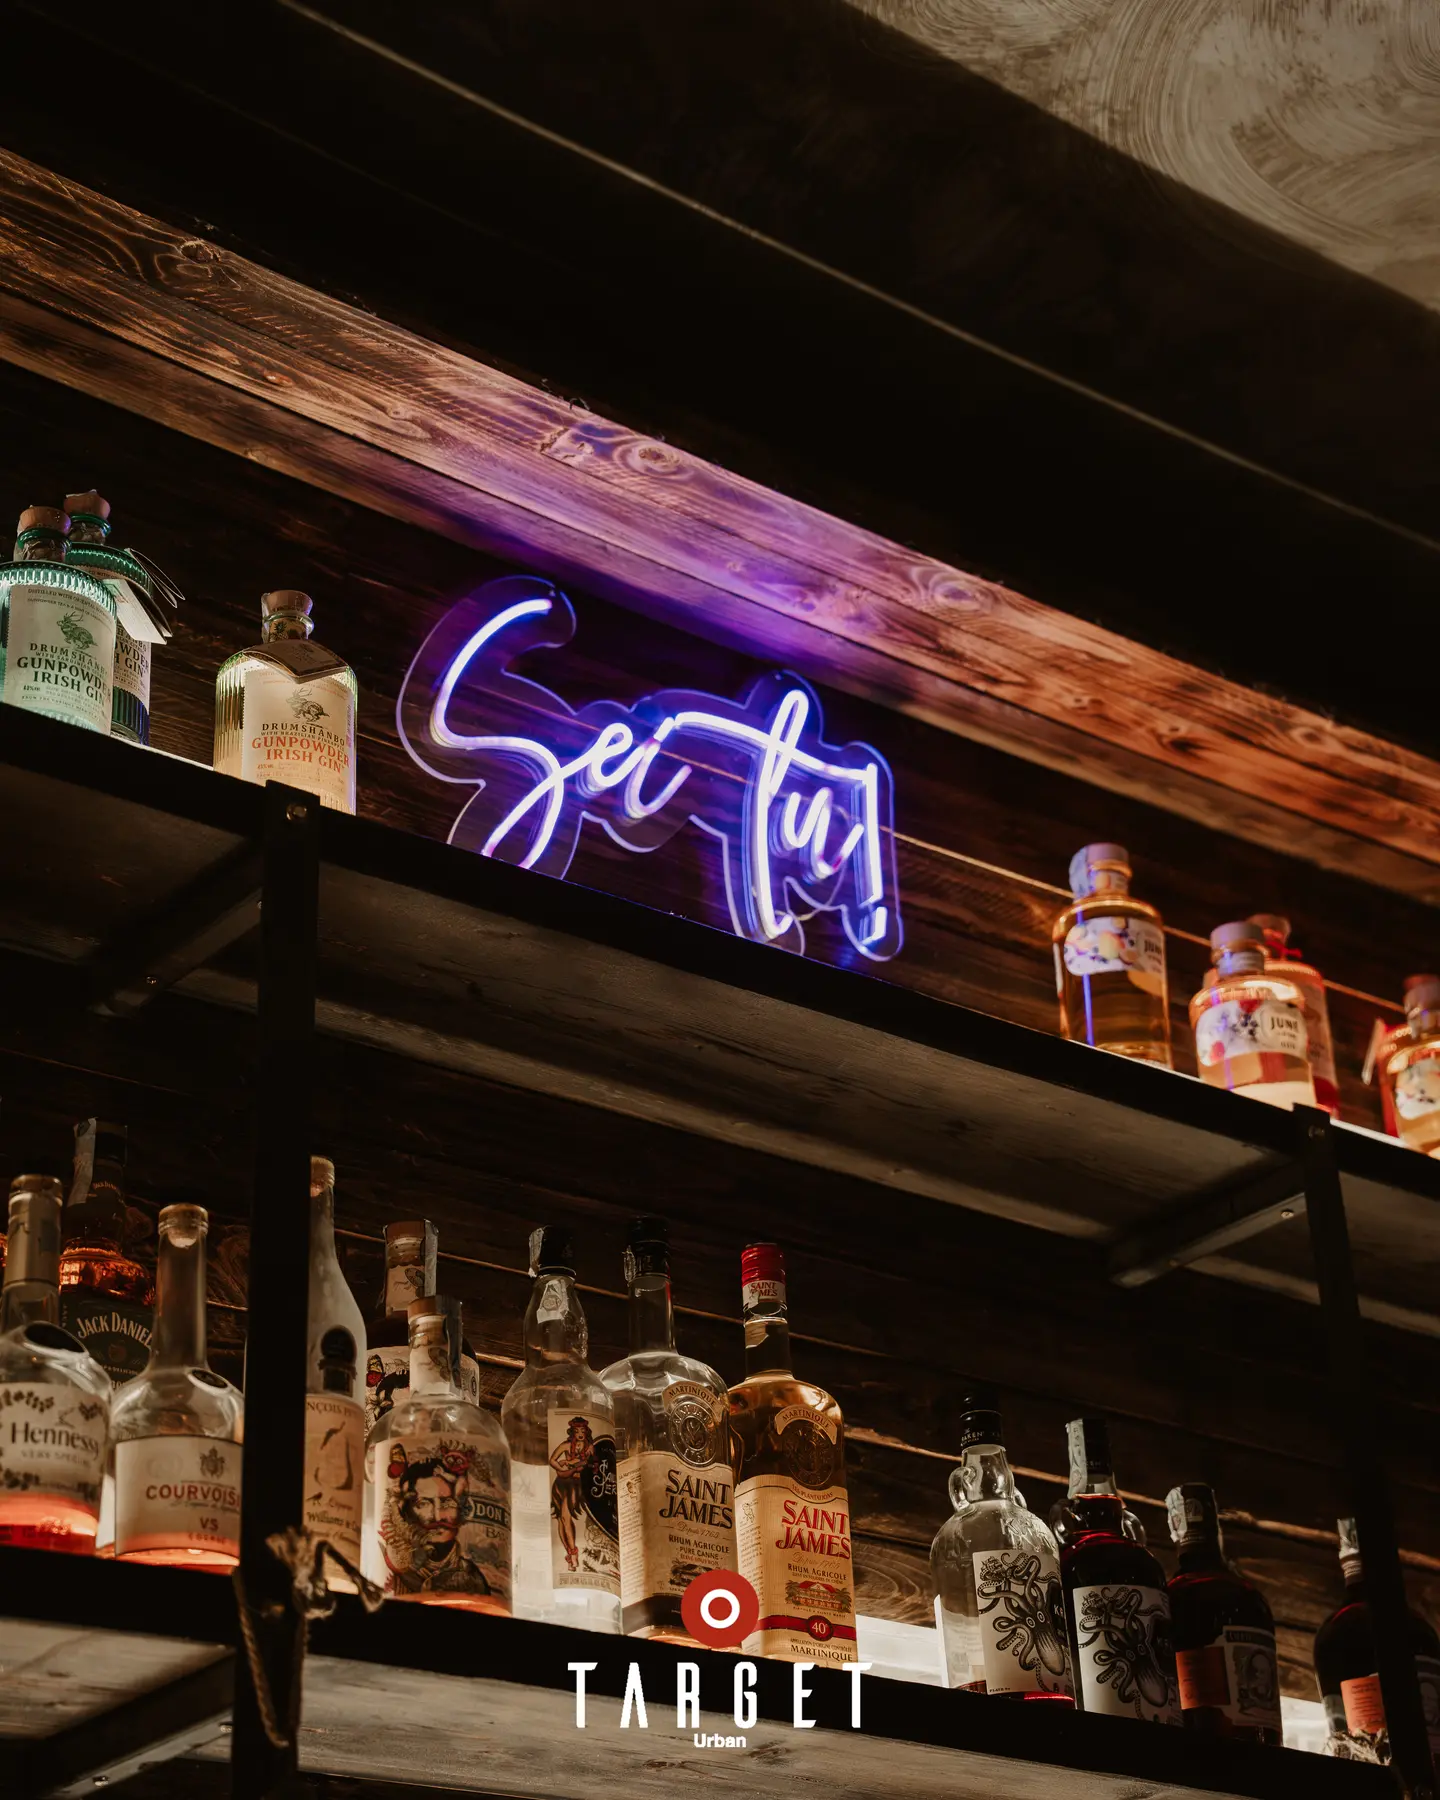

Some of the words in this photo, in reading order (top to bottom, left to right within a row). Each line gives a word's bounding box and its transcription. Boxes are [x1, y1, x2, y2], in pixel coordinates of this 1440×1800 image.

[17, 656, 111, 698] GUNPOWDER
[33, 671, 80, 692] IRISH
[86, 685, 105, 707] GIN
[262, 723, 345, 746] DRUMSHANBO
[252, 736, 350, 768] GUNPOWDER
[266, 749, 312, 763] IRISH
[318, 755, 342, 774] GIN
[750, 1282, 777, 1290] SAINT
[77, 1316, 109, 1339] JACK
[668, 1384, 715, 1408] MARTINIQUE
[782, 1410, 830, 1429] MARTINIQUE
[666, 1469, 731, 1504] SAINT
[199, 1515, 219, 1532] VS
[476, 1502, 502, 1522] DON
[658, 1496, 733, 1530] JAMES
[782, 1499, 848, 1536] SAINT
[668, 1533, 691, 1546] RHUM
[693, 1539, 731, 1554] AGRICOLE
[679, 1546, 696, 1556] PURE
[697, 1549, 719, 1560] CANNE
[775, 1525, 851, 1560] JAMES
[787, 1563, 809, 1574] RHUM
[811, 1568, 847, 1581] AGRICOLE
[790, 1644, 853, 1662] MARTINIQUE
